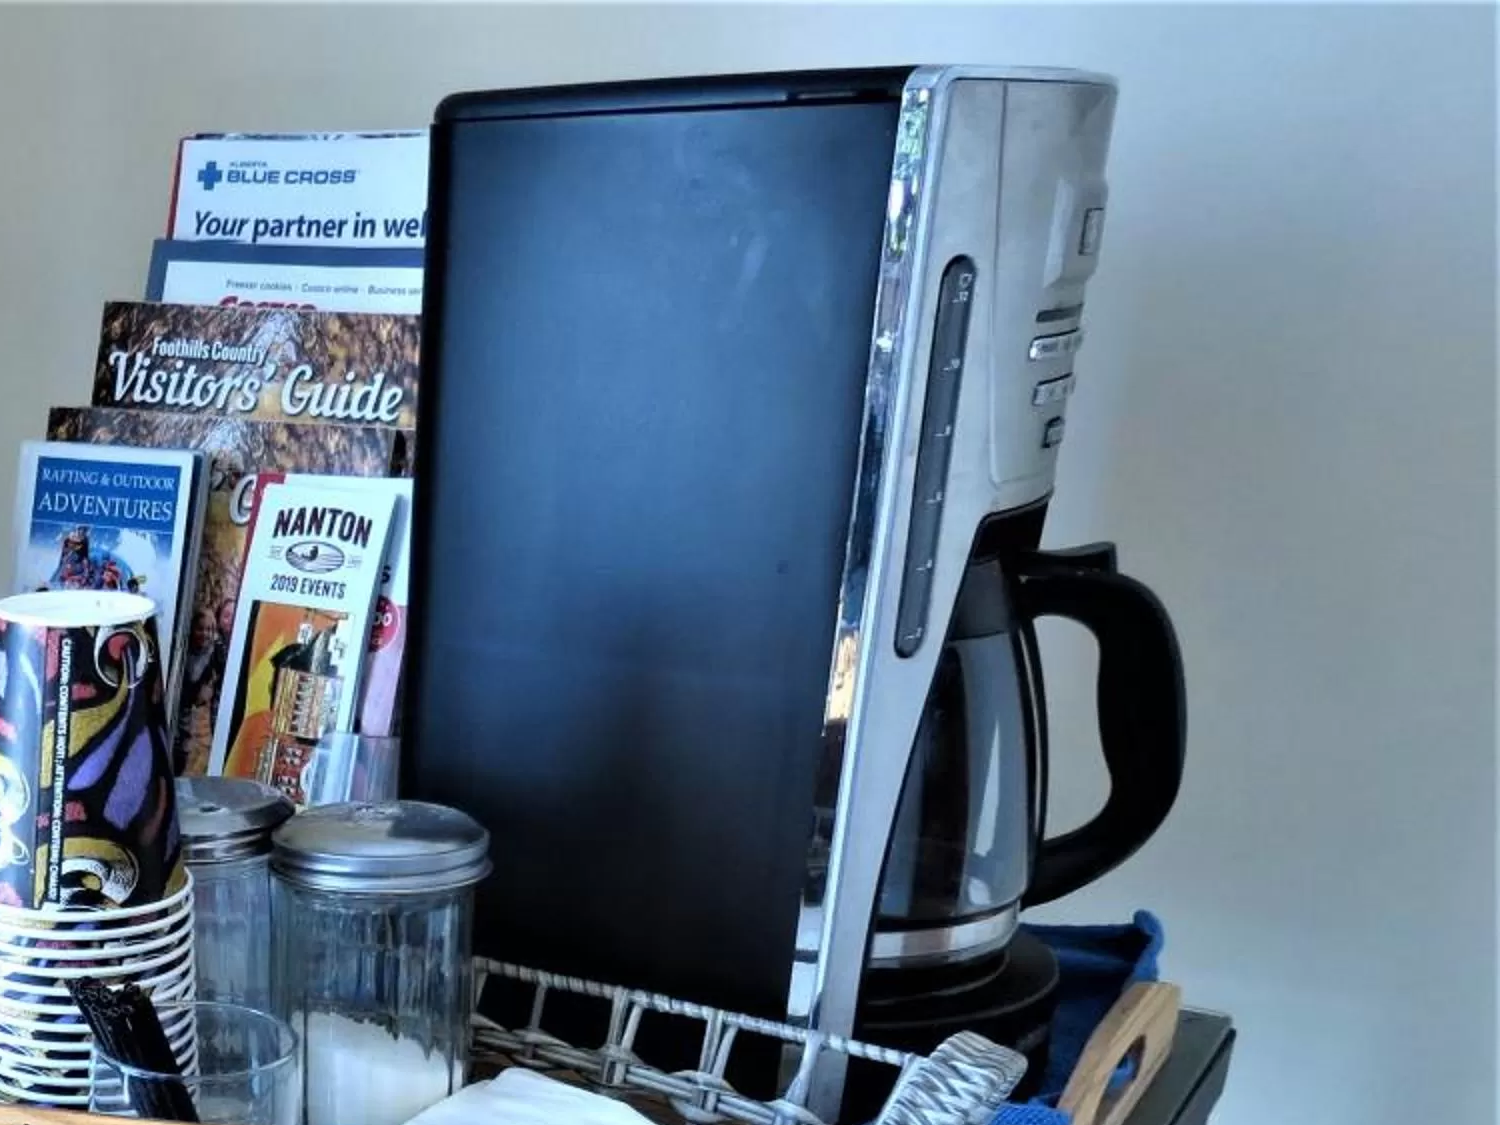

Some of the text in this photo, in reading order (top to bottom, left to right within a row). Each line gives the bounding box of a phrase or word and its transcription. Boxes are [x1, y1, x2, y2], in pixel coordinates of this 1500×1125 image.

[227, 169, 357, 185] BLUE CROSS
[195, 210, 250, 237] Your
[251, 214, 349, 244] partner
[353, 210, 376, 239] in
[151, 336, 269, 367] Foothills Country
[281, 364, 404, 420] Guide
[40, 467, 177, 492] RAFTING & OUTDOOR
[37, 492, 173, 522] ADVENTURES
[272, 506, 373, 549] NANTON
[269, 573, 347, 599] 2019 EVENTS
[57, 686, 70, 735] CONTENTS
